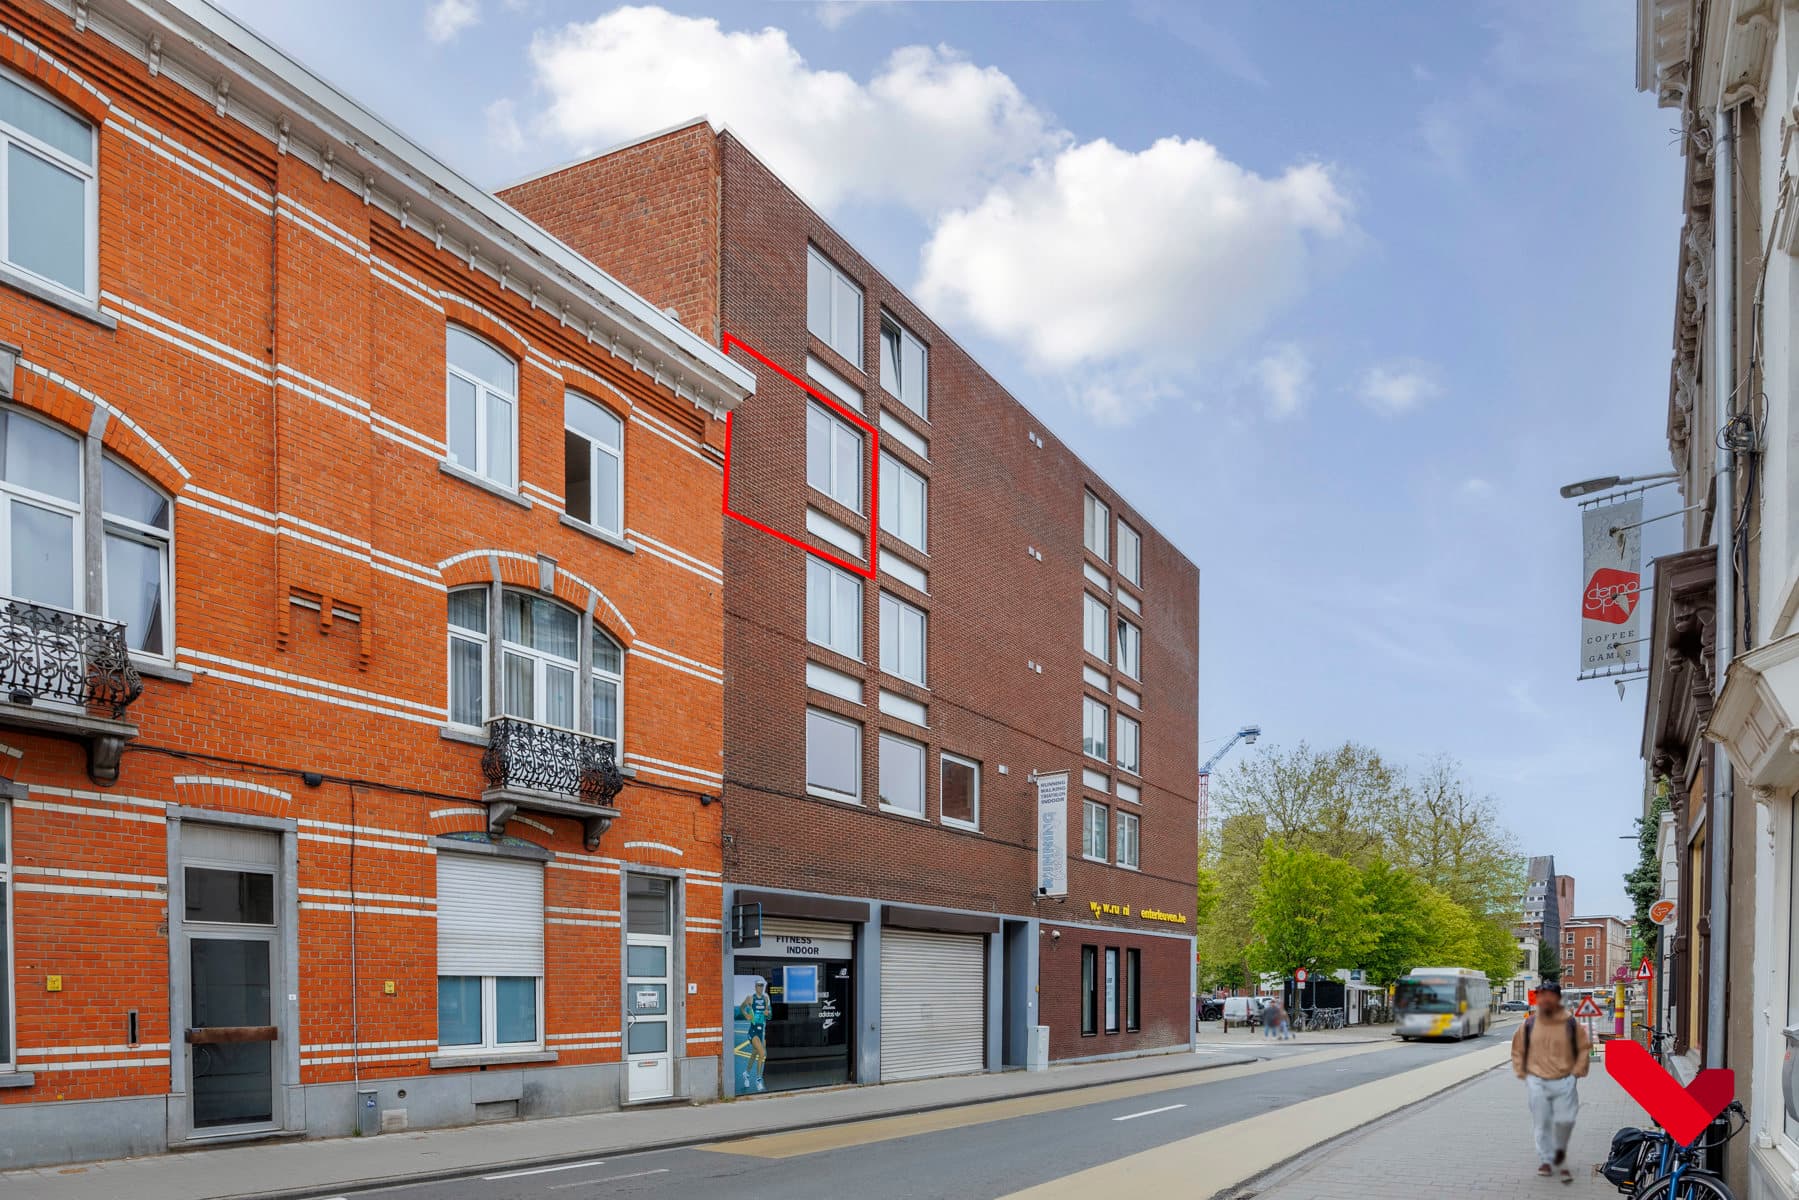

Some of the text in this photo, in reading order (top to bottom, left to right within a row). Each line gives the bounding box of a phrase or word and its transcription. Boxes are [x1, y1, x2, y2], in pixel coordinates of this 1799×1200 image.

[1587, 582, 1638, 599] demo
[1585, 596, 1635, 614] Sp
[1587, 630, 1634, 644] COFFEE
[776, 936, 812, 944] FITNESS
[786, 946, 820, 955] INDOOR
